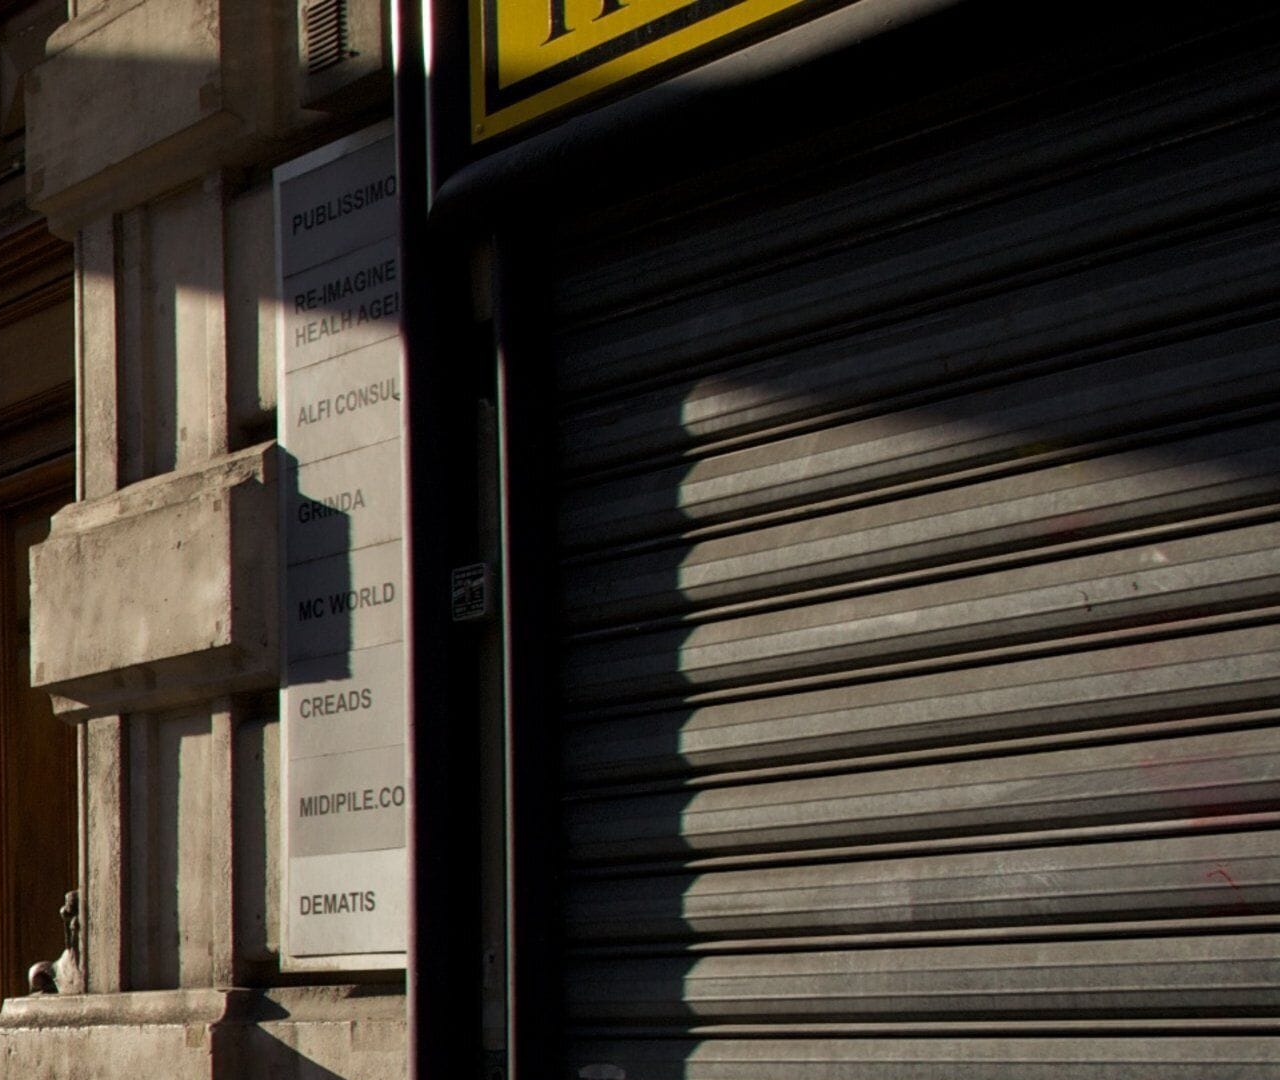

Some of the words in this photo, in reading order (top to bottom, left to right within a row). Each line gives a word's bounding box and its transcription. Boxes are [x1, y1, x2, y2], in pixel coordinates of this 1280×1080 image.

[292, 174, 397, 236] PUBLISSIMO
[294, 259, 397, 315] RE-IMAGINE
[295, 307, 354, 348] HEALH
[297, 396, 332, 429] ALFI
[297, 487, 366, 526] GRINDA
[298, 594, 325, 622] MC
[328, 581, 396, 616] WORLD
[299, 687, 373, 720] CREADS
[299, 890, 376, 917] DEMATIS
